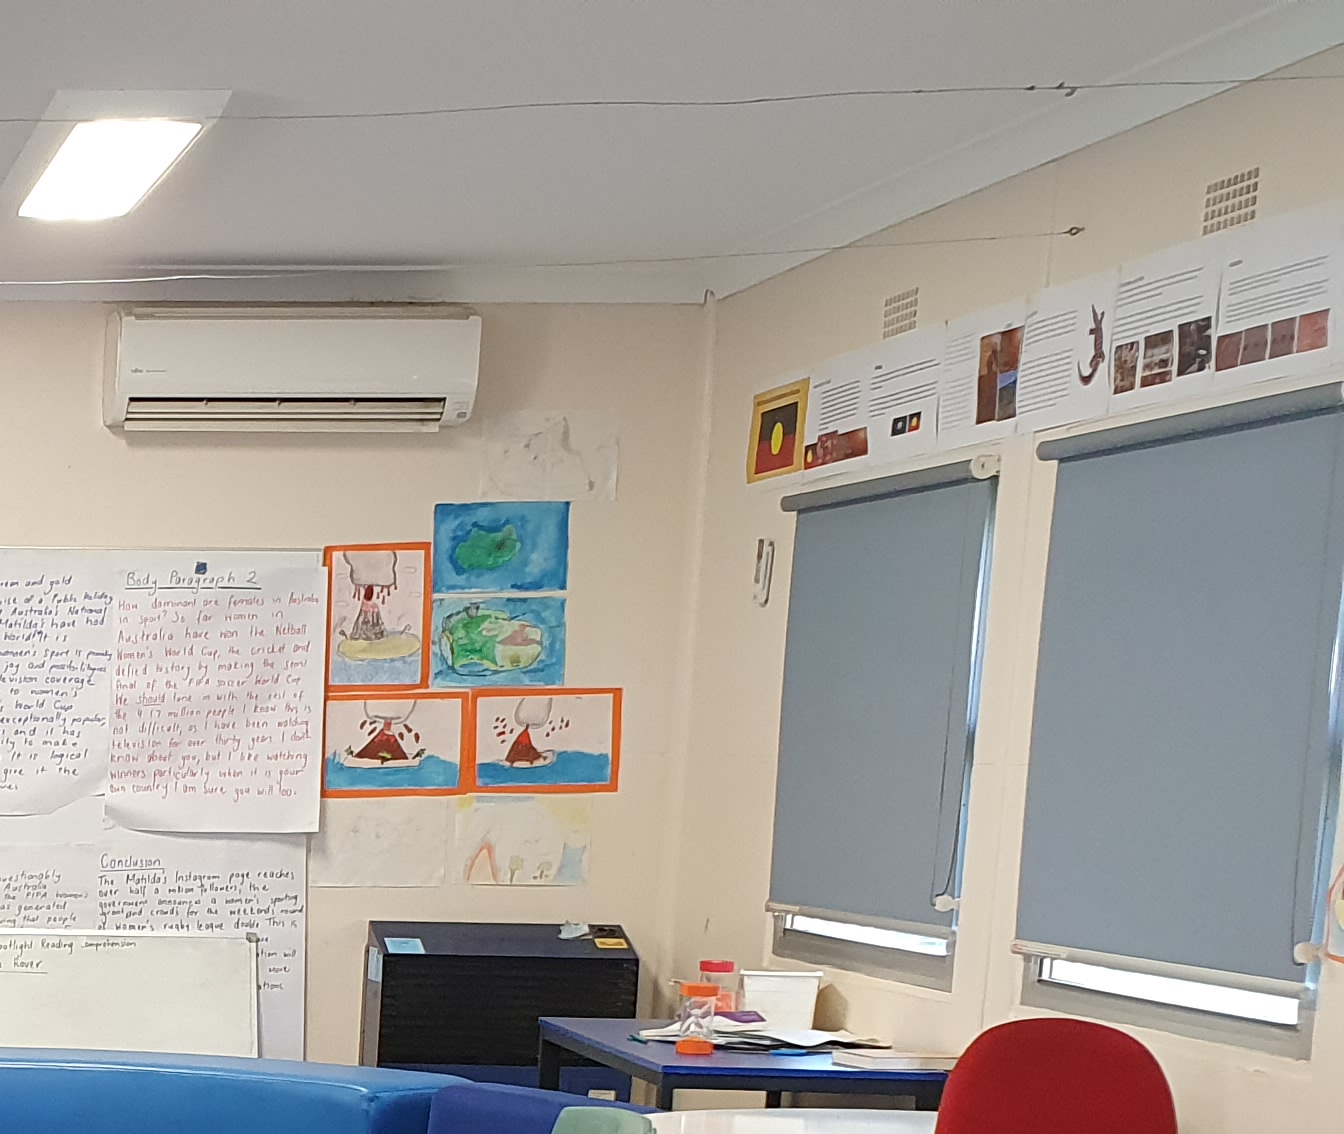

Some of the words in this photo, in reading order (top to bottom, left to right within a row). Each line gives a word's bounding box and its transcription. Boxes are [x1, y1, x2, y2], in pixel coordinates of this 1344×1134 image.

[126, 572, 157, 596] Body
[169, 572, 234, 594] Paragraph
[247, 571, 258, 584] 2
[101, 854, 161, 868] Conclusion
